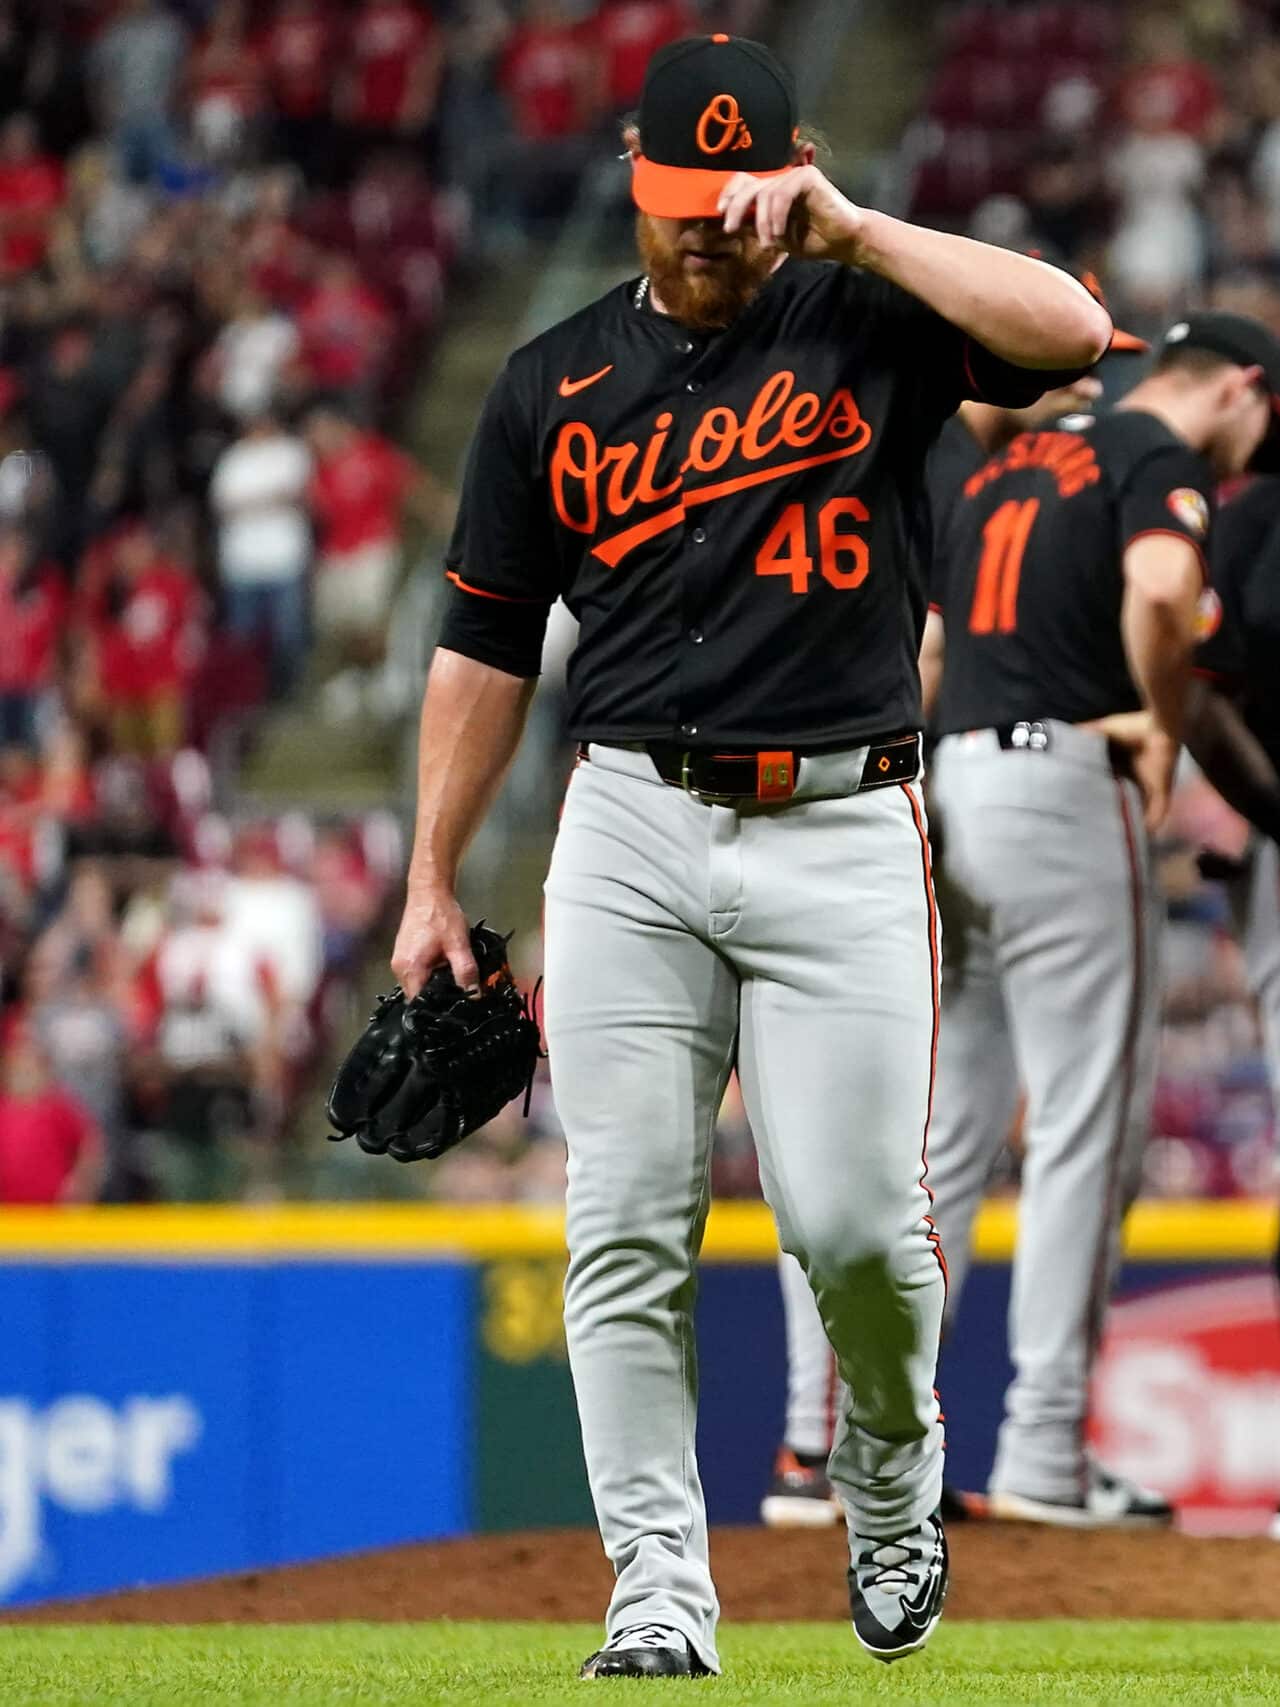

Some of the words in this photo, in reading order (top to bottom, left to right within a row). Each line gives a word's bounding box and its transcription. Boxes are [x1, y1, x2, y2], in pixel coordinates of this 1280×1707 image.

[551, 370, 872, 540] Orioles
[755, 496, 870, 594] 46
[968, 498, 1040, 635] 11
